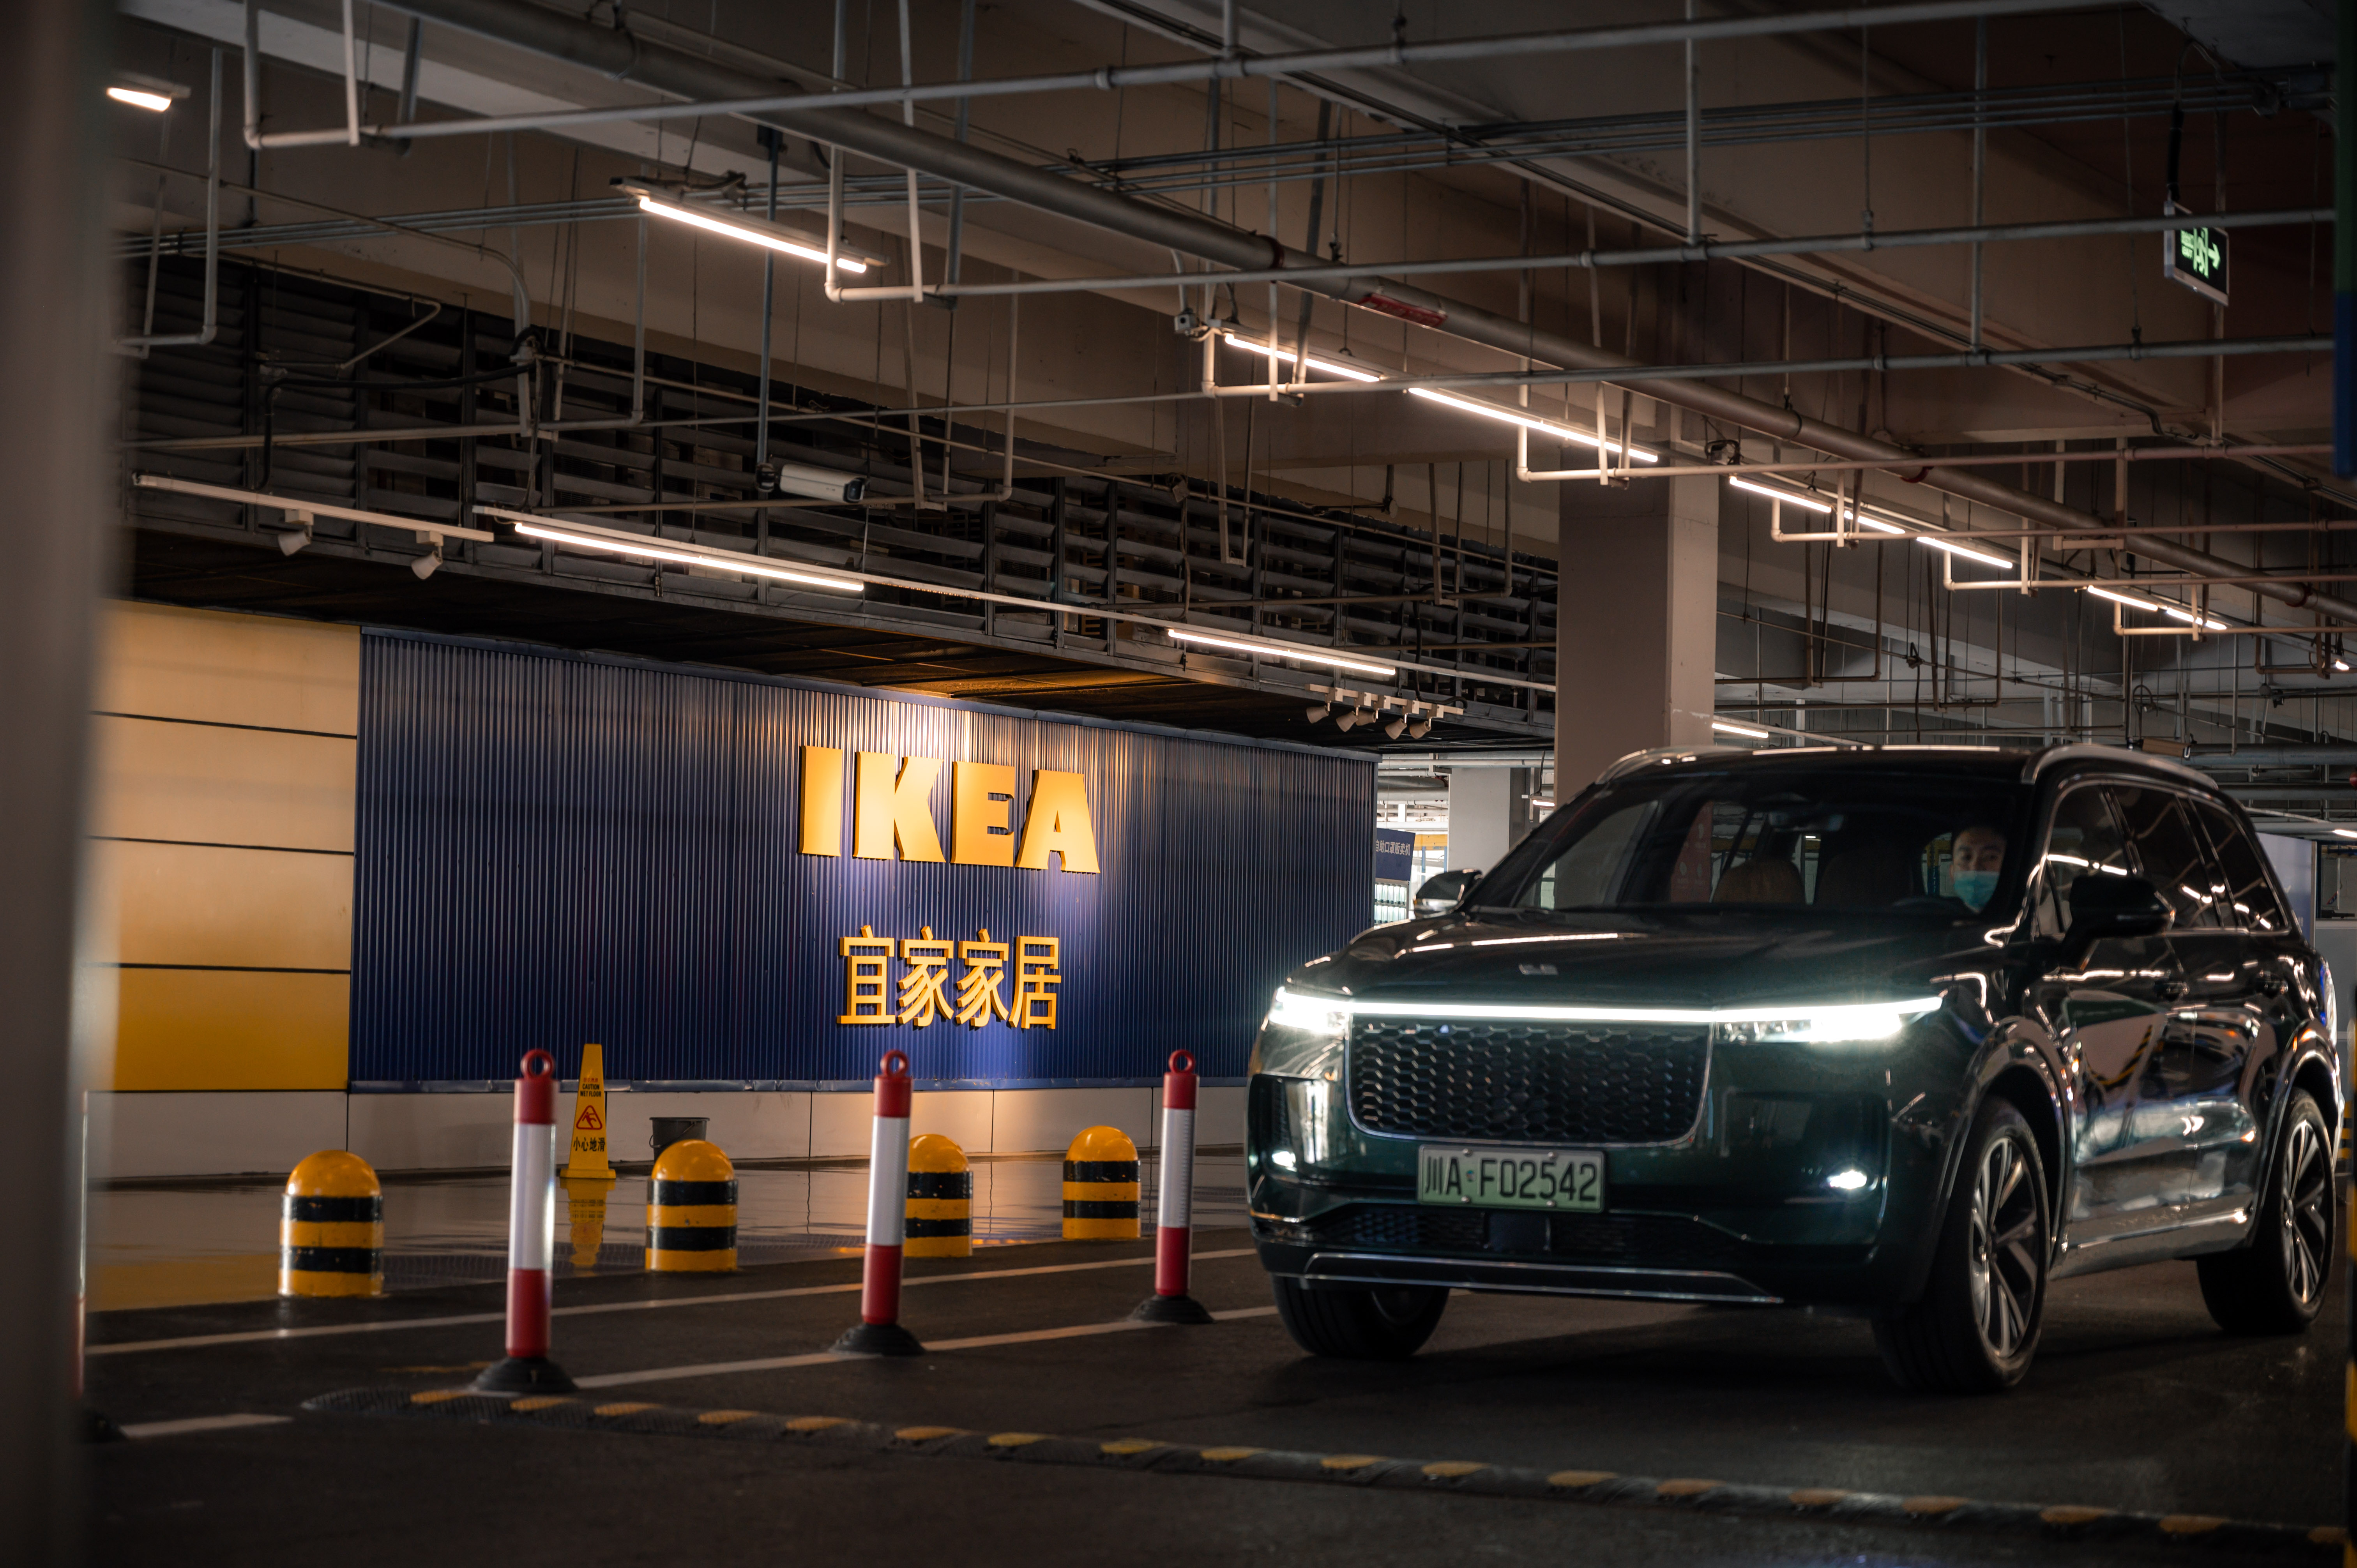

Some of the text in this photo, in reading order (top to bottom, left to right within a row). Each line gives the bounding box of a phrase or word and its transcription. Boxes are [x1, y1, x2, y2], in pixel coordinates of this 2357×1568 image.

[798, 745, 1100, 874] IKEA
[1376, 839, 1411, 856] 自助口罩贩卖机
[837, 925, 1061, 1029] 宜家家居
[573, 1136, 605, 1152] 小心地滑
